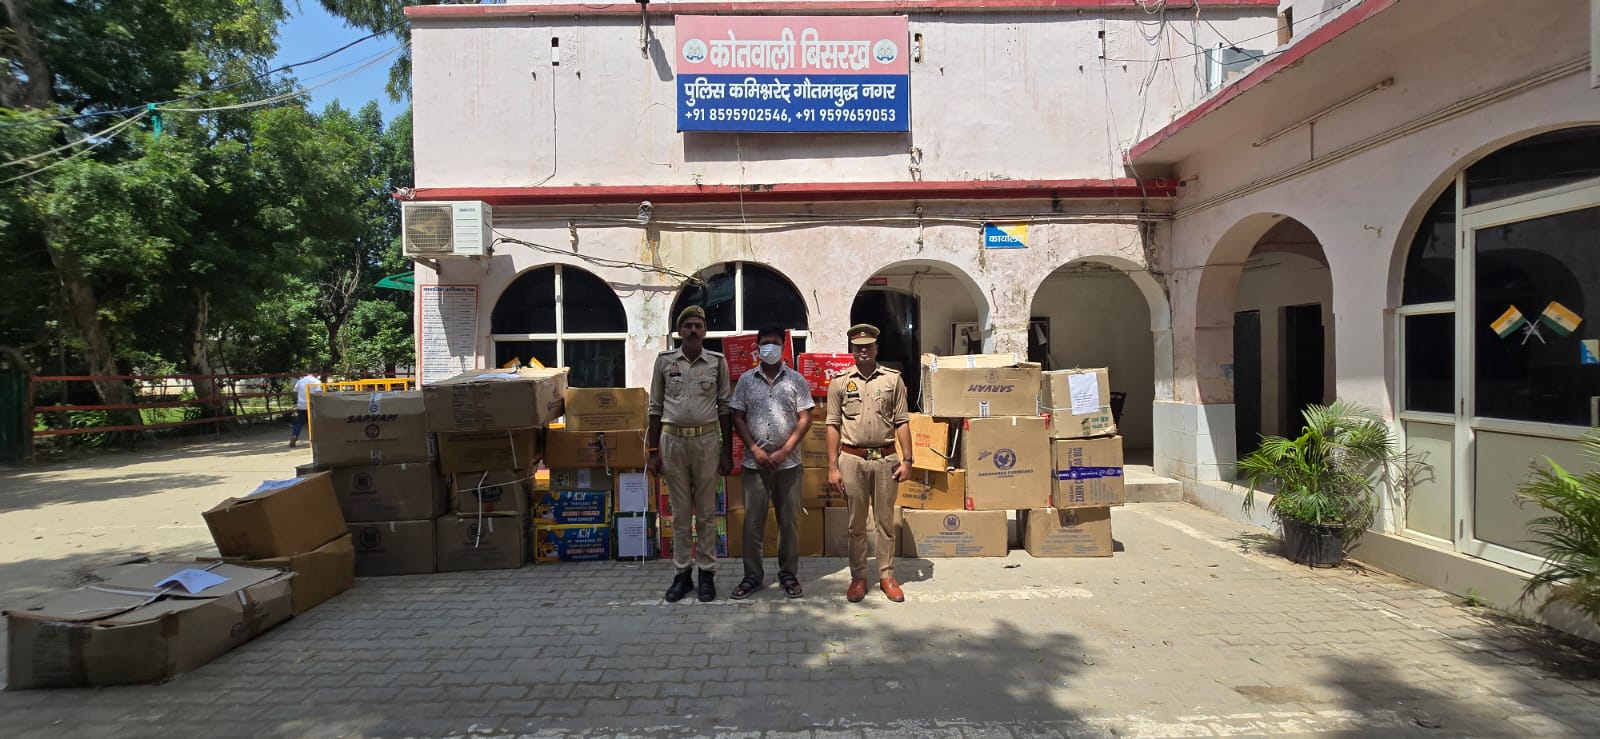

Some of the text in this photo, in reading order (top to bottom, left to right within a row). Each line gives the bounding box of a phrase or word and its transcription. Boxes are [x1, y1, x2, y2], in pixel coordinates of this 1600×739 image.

[709, 27, 871, 70] कोतवाली बिसरख
[684, 76, 726, 107] पुलिस
[793, 76, 860, 108] गौतमबुद्ध
[862, 83, 897, 100] नगर
[685, 108, 896, 123] +91 8595902546, +91 9599659053
[967, 384, 1015, 393] SARVAM
[345, 413, 399, 424] SARVAM
